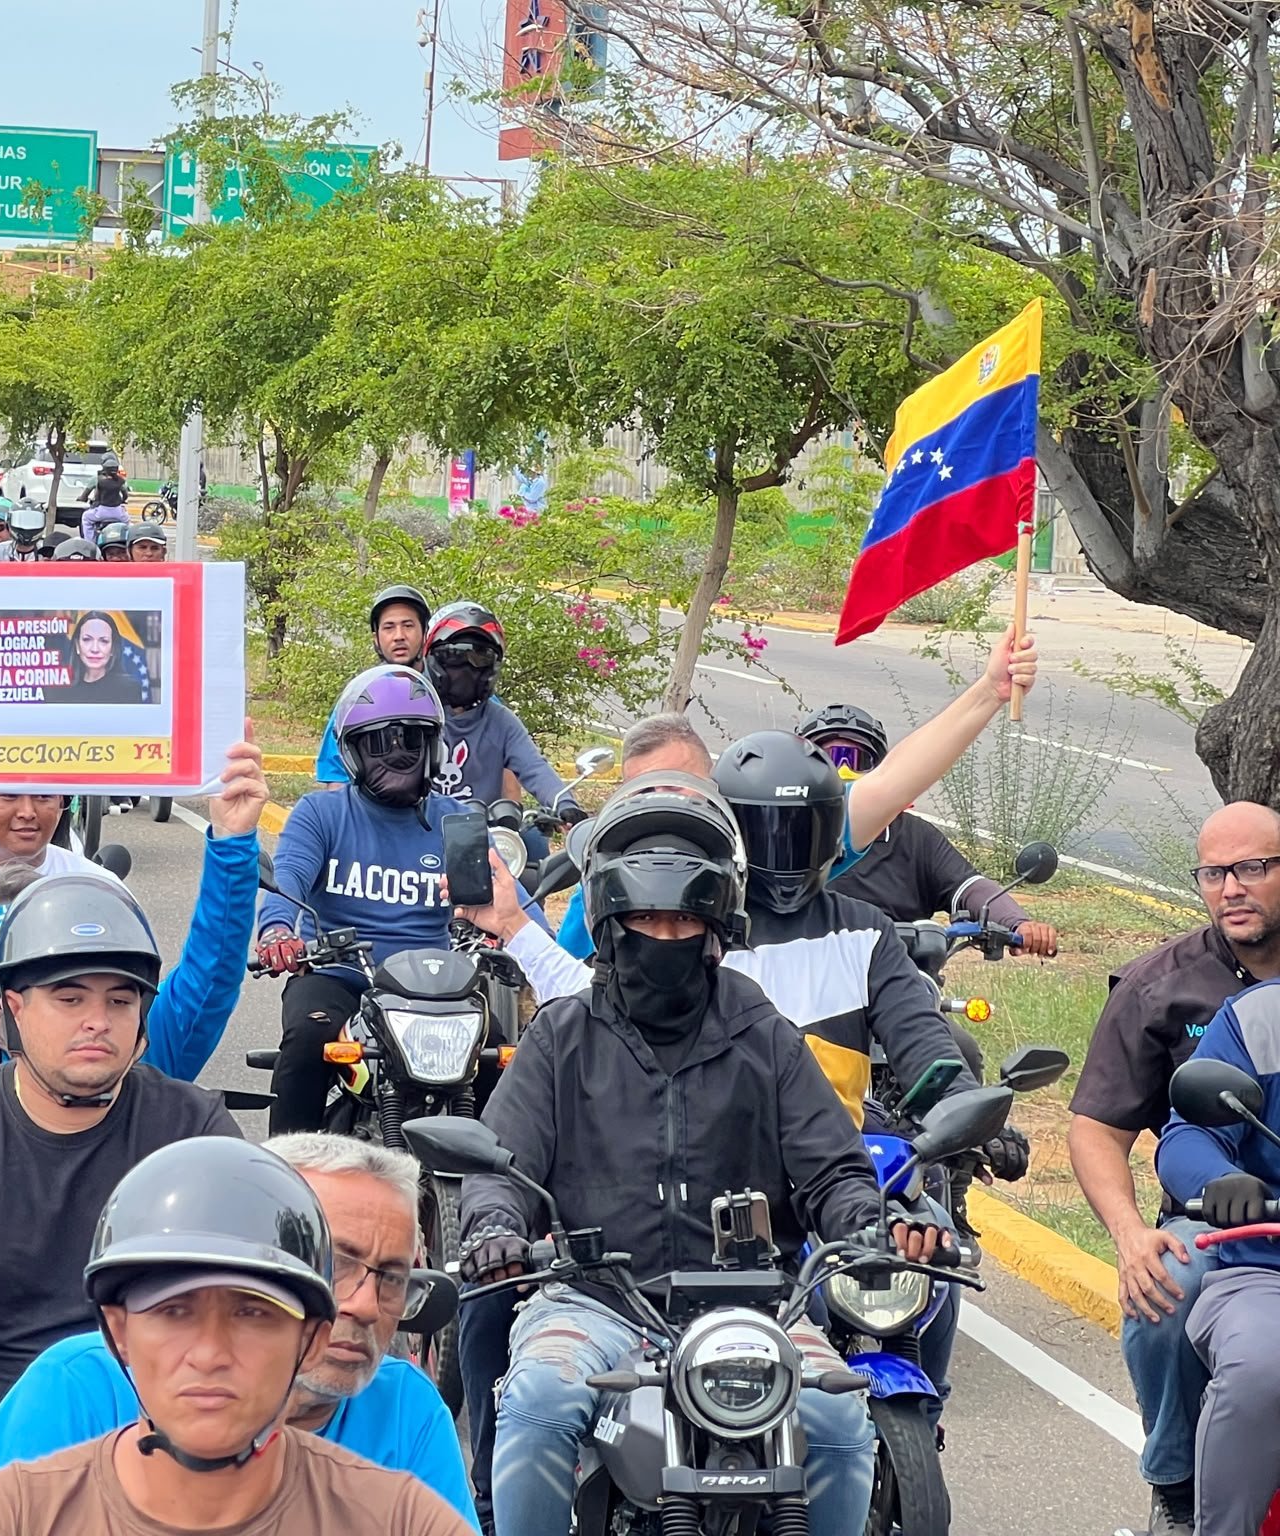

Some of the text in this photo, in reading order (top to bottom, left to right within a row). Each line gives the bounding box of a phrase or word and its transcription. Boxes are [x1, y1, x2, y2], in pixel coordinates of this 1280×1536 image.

[0, 621, 16, 635] LA
[17, 617, 68, 635] PRESIÓN
[42, 651, 60, 666] DE
[15, 668, 71, 686] CORINA
[326, 858, 450, 907] LACOST
